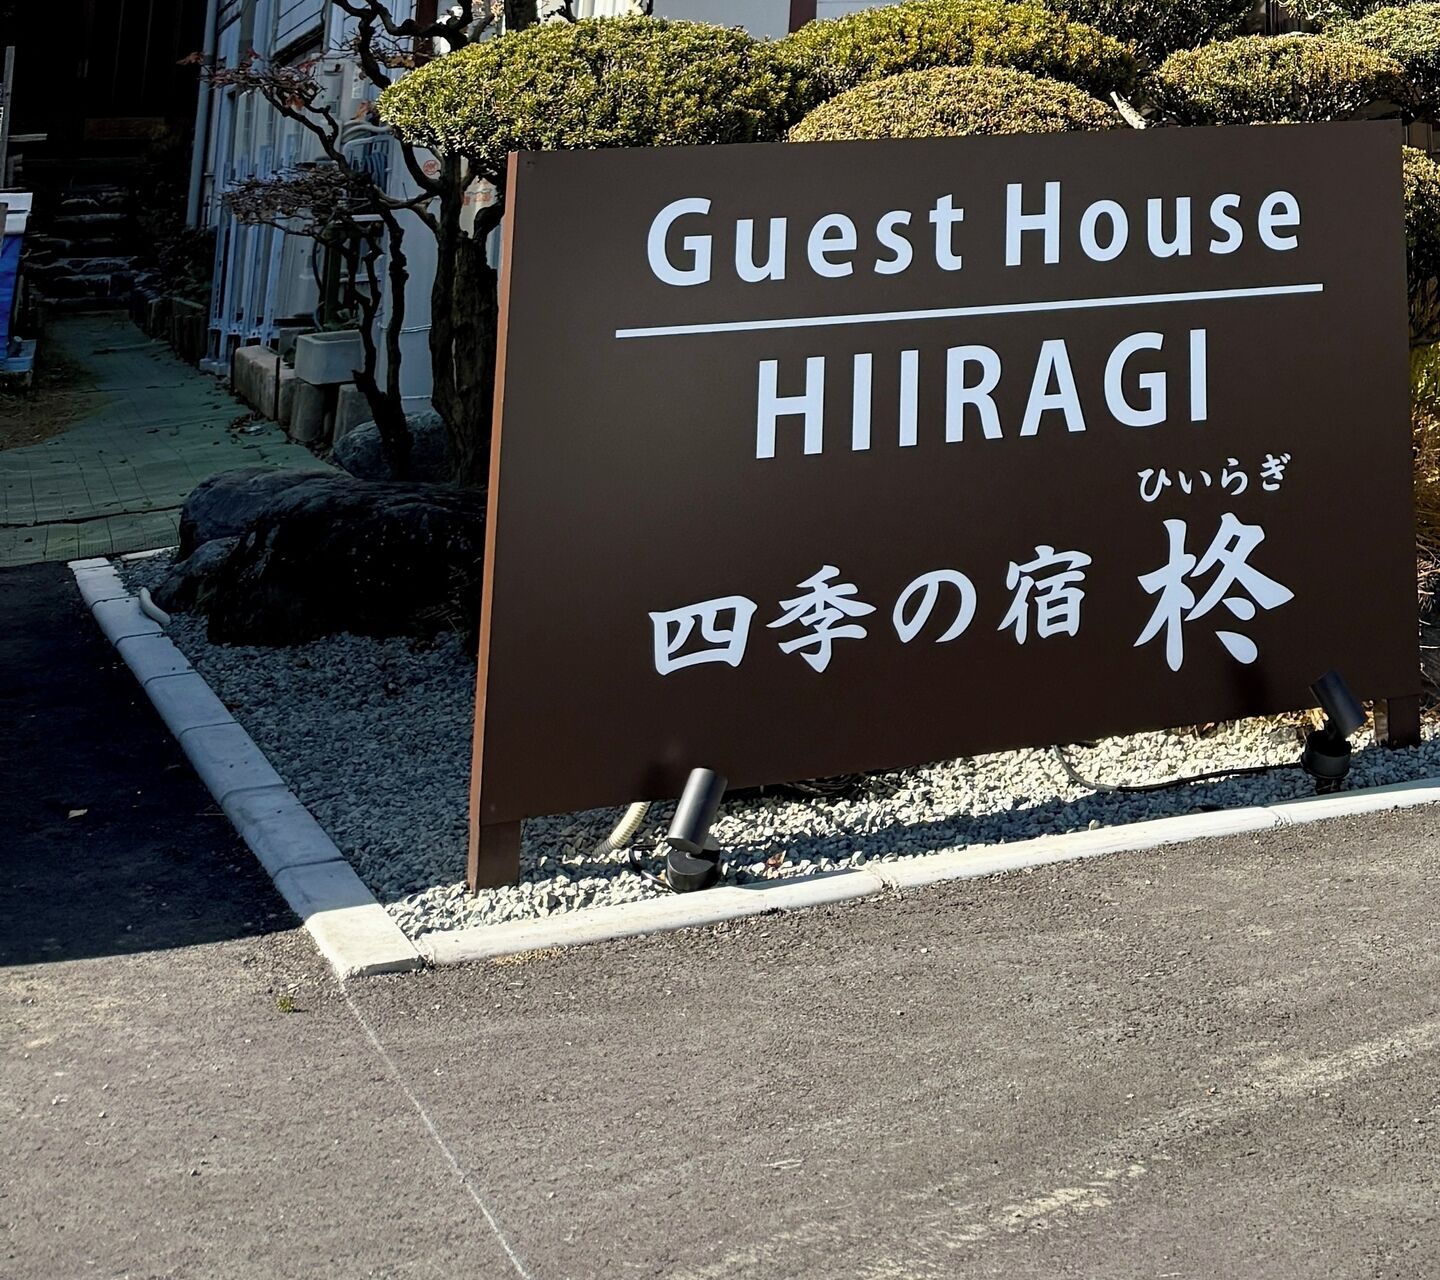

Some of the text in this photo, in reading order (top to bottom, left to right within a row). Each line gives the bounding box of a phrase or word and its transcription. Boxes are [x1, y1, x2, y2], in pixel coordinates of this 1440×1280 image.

[646, 180, 1302, 287] Guest House
[755, 328, 1208, 460] HIIRAGI
[1136, 452, 1292, 503] ひいらぎ
[647, 511, 1296, 677] 四季の宿 柊
